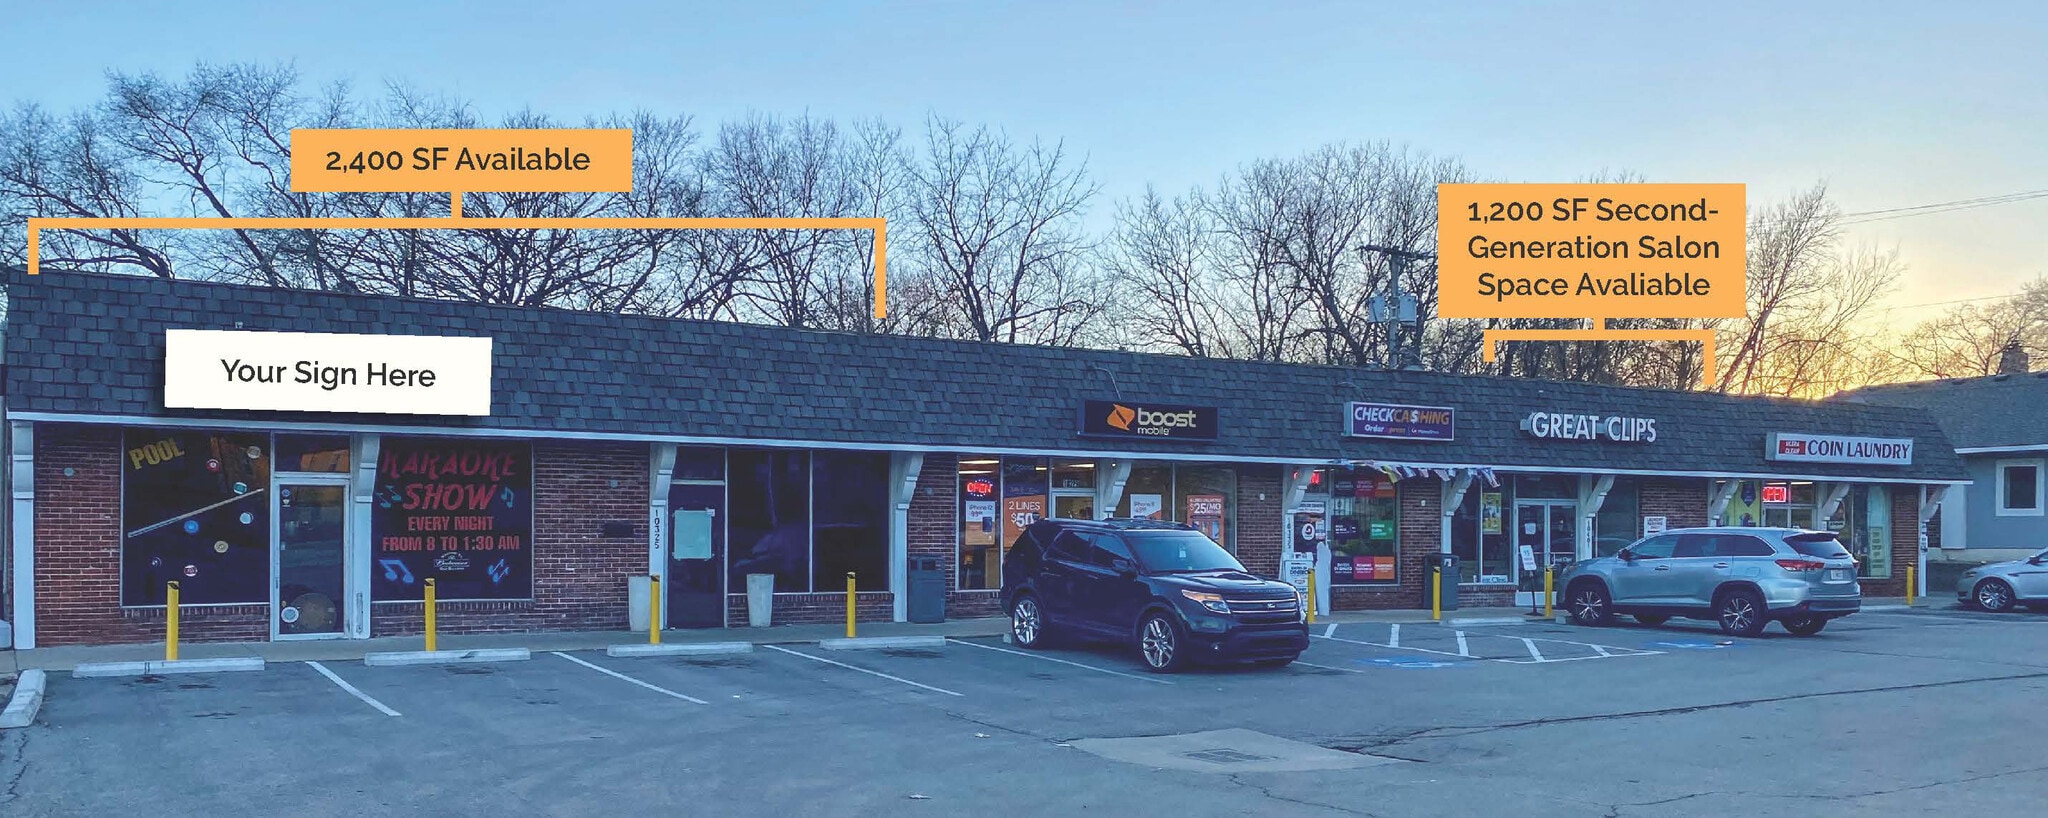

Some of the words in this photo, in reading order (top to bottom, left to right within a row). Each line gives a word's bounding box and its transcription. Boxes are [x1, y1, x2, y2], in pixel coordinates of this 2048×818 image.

[1137, 407, 1197, 428] boost
[1137, 427, 1170, 436] mobile
[1364, 424, 1385, 432] Order
[1532, 411, 1600, 440] GREAT
[1607, 416, 1657, 442] CLIPS
[128, 439, 185, 470] POOL
[1807, 439, 1844, 456] COIN
[1847, 442, 1911, 459] LAUNDRY
[381, 450, 518, 482] KARAOKE
[966, 481, 993, 494] OPEN
[1762, 487, 1784, 500] OPEN
[402, 482, 499, 511] SHOW
[1008, 501, 1016, 510] 2
[1016, 501, 1041, 510] LINES
[407, 516, 450, 531] EVERY
[454, 516, 495, 531] NIGHT
[381, 537, 422, 551] FROM
[427, 537, 435, 551] 8
[440, 537, 458, 550] TO
[463, 536, 494, 551] 1:30
[498, 536, 521, 550] AM
